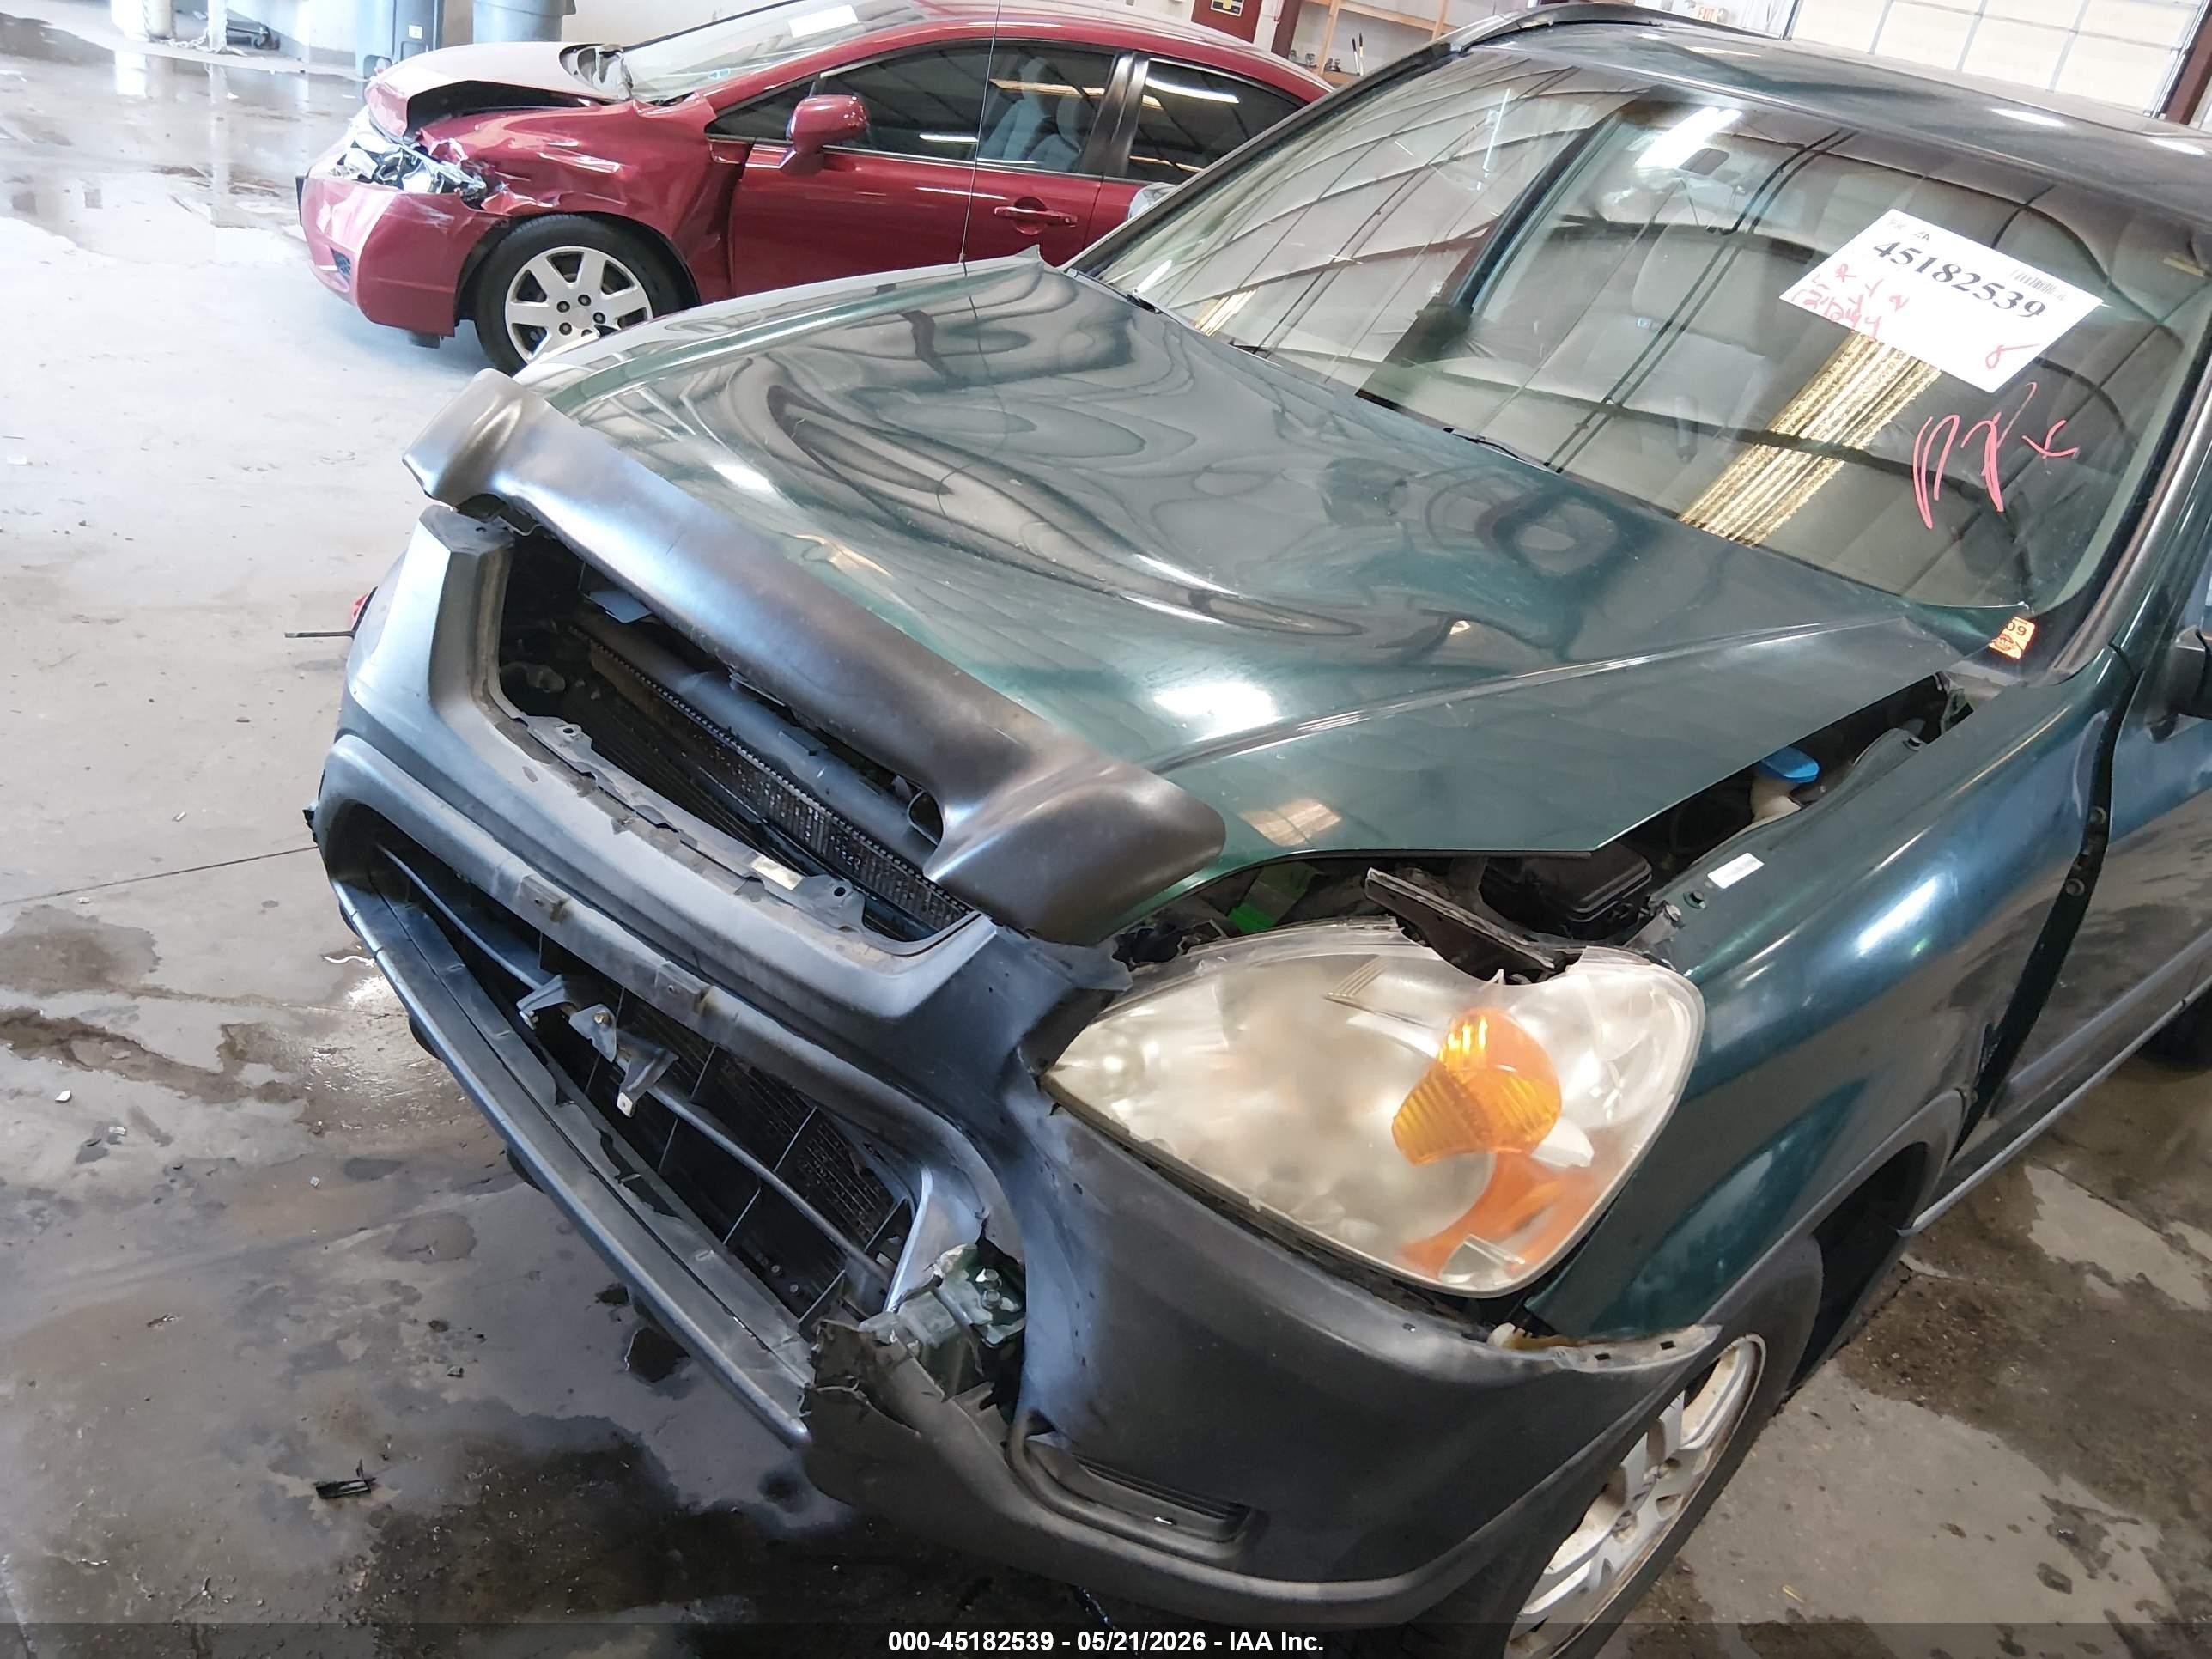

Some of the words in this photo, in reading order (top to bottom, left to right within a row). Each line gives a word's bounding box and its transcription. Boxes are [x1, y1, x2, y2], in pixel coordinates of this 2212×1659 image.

[1698, 7, 1715, 21] EXIT
[1873, 240, 2047, 319] 45182539
[2007, 621, 2027, 635] 09
